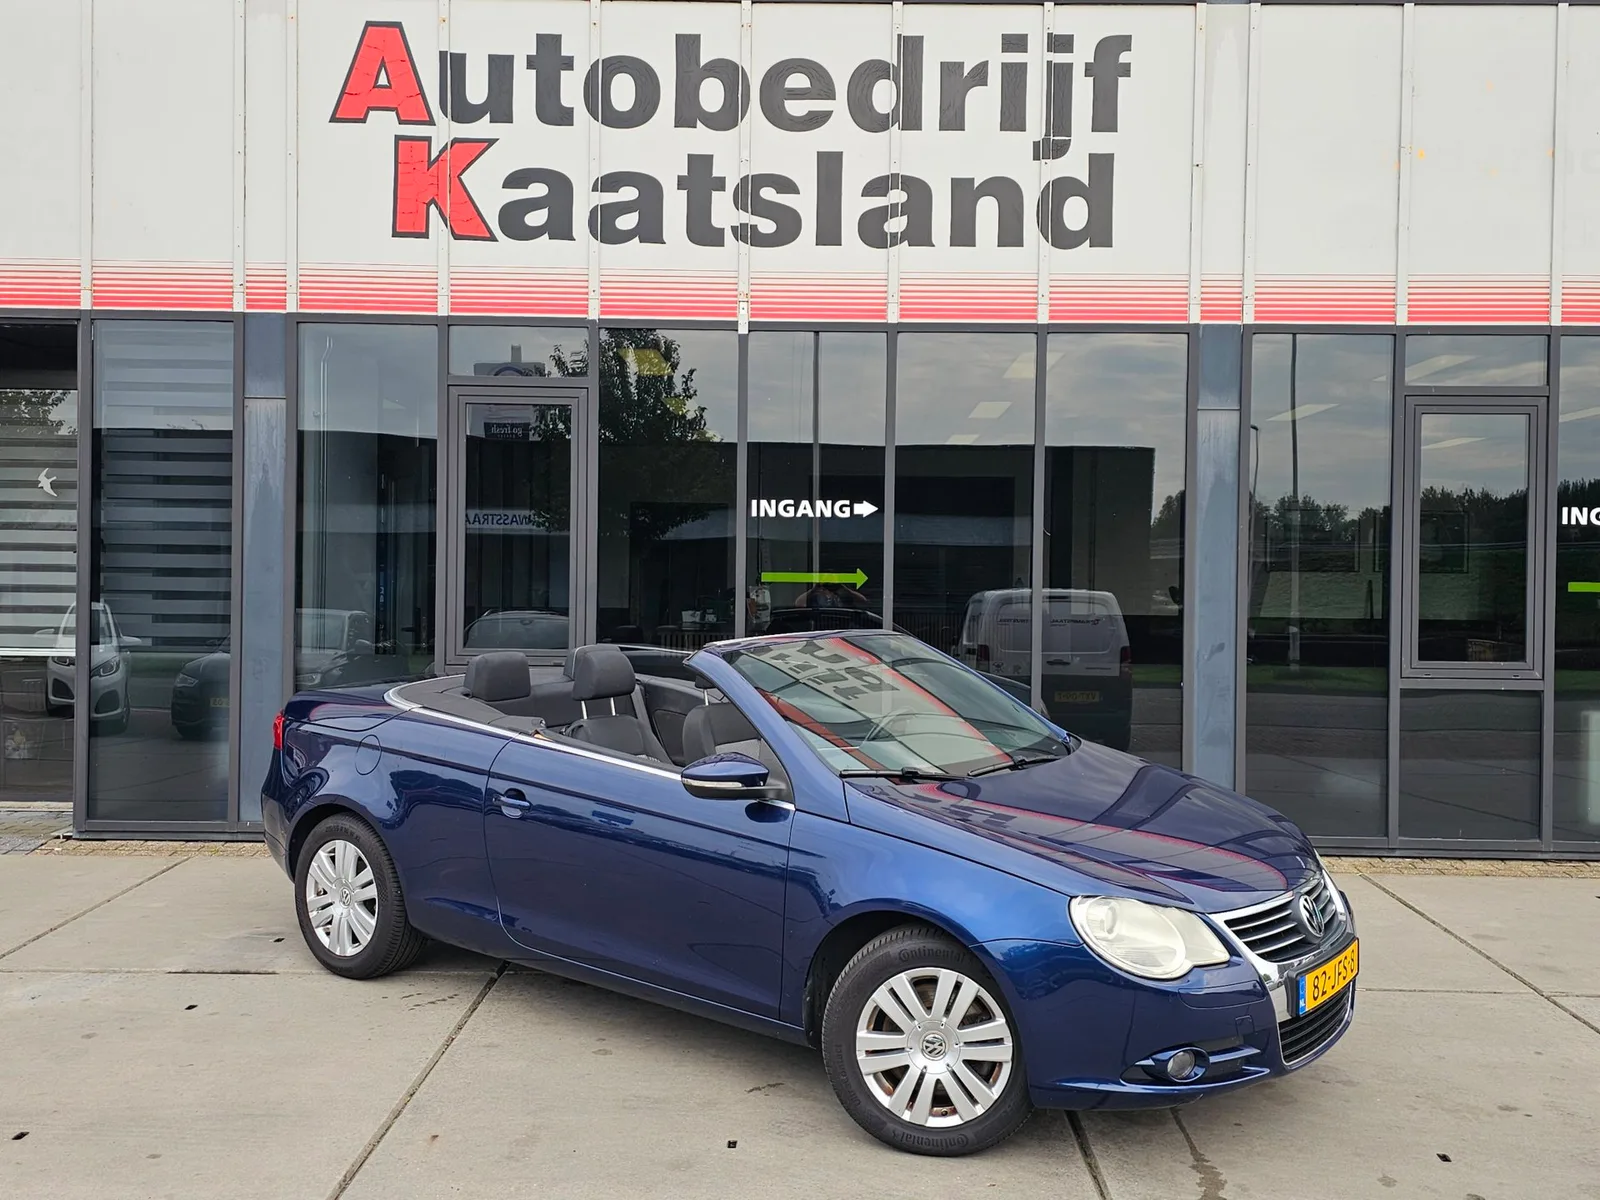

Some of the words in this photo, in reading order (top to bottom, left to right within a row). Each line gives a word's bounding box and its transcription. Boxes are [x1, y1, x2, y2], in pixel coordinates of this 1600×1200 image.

[329, 21, 1132, 160] Autobedrijf
[391, 135, 1115, 249] Kaatsland
[751, 499, 850, 518] INGANG
[1312, 949, 1355, 1001] 82-JFS-8
[900, 1131, 969, 1150] Continental
